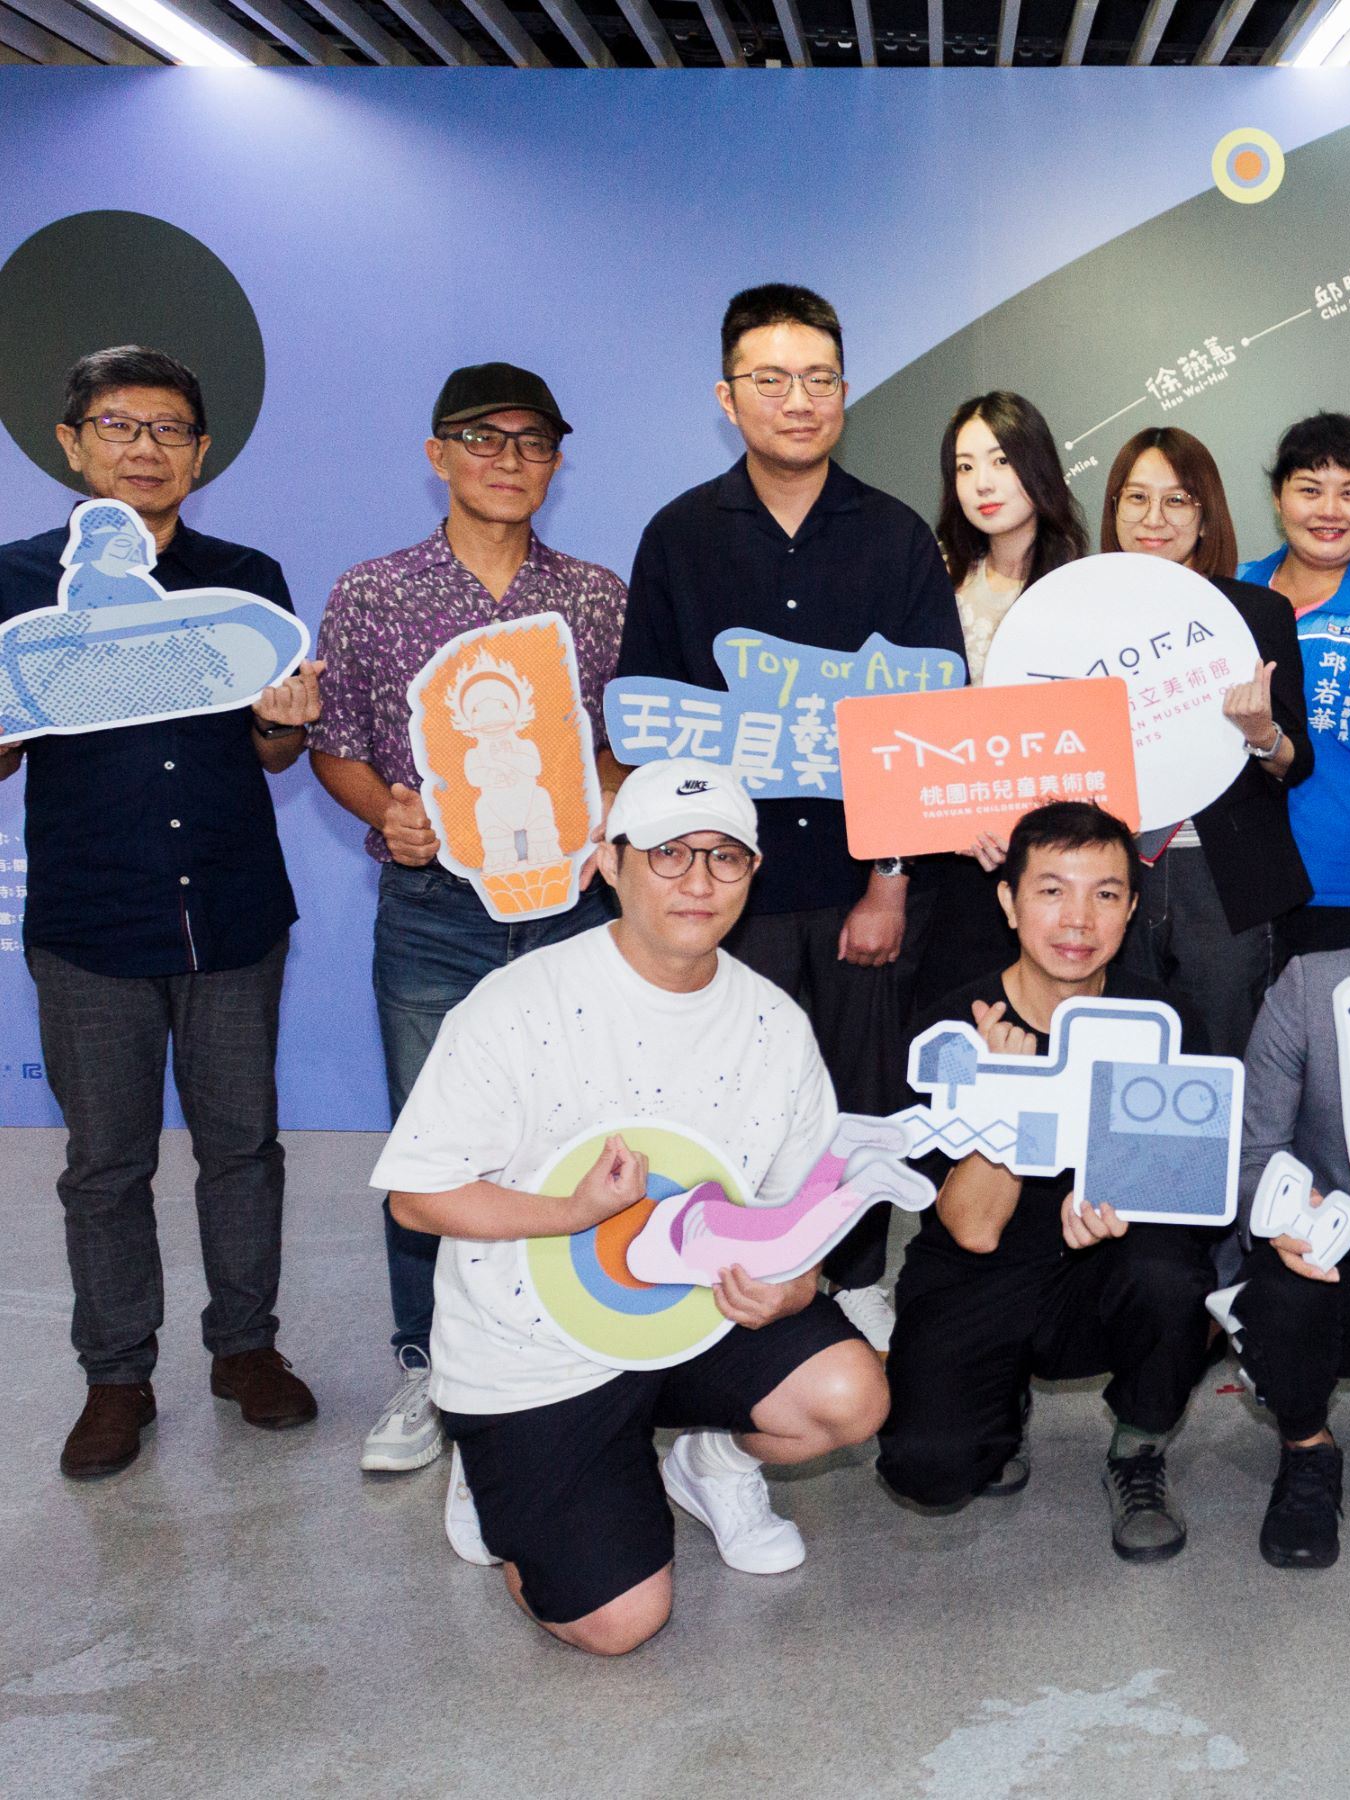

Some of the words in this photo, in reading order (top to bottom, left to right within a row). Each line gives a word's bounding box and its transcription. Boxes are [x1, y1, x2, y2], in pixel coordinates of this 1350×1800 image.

[1321, 304, 1347, 319] Chiu
[725, 638, 799, 708] Toy
[820, 655, 855, 679] or
[1153, 693, 1213, 722] MUSEUM
[1308, 651, 1347, 734] 邱若華
[872, 730, 1086, 770] TMOFA
[1135, 731, 1162, 748] RTS
[920, 770, 1106, 806] 桃園市兒童美術館
[922, 808, 972, 819] TAOYUAN
